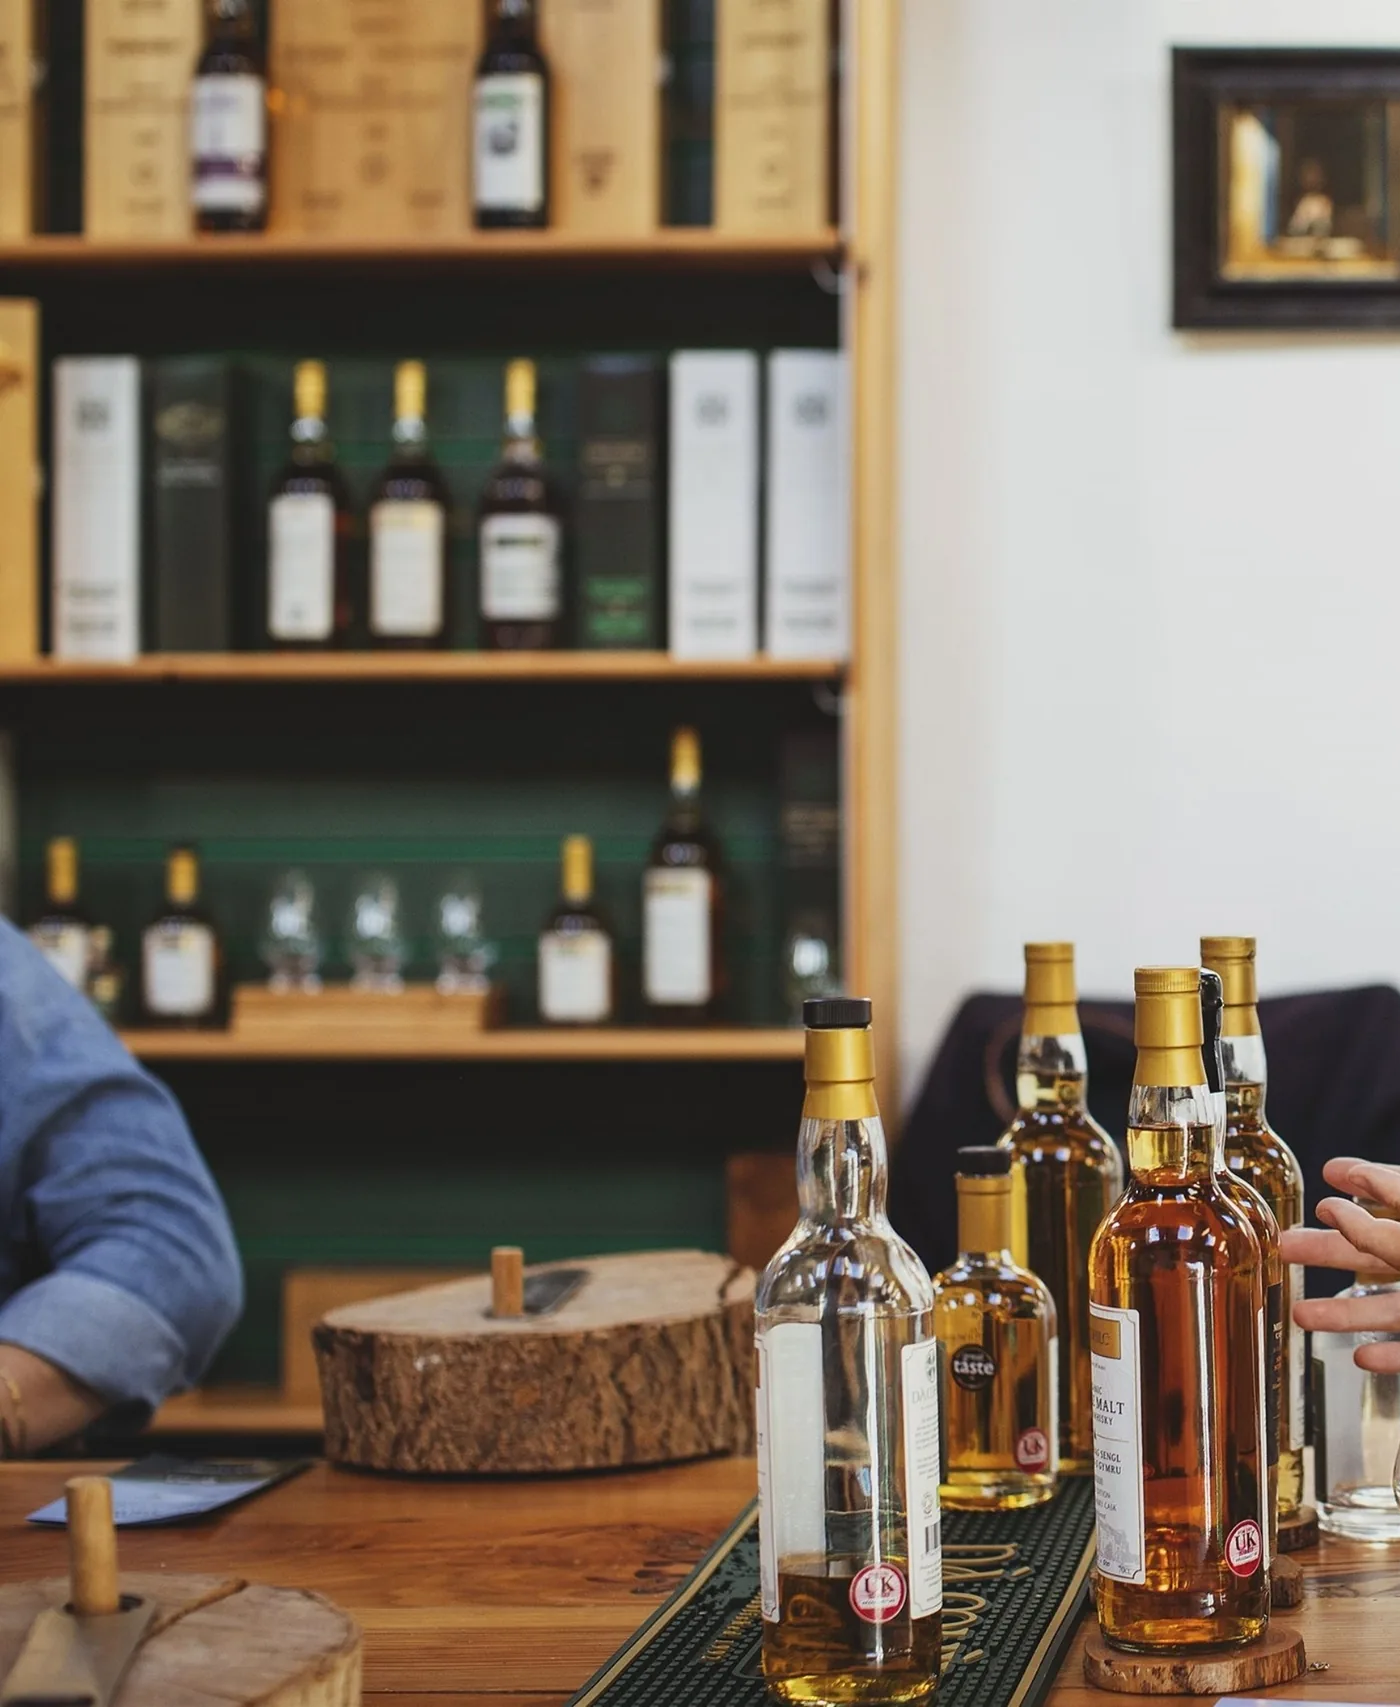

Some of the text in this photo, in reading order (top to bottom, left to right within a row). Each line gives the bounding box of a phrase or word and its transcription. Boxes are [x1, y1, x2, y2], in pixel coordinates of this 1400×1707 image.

[953, 1359, 995, 1376] taste
[1095, 1396, 1125, 1416] MALT
[1099, 1449, 1122, 1464] SENGL
[1234, 1529, 1258, 1552] UK
[864, 1575, 896, 1595] UK
